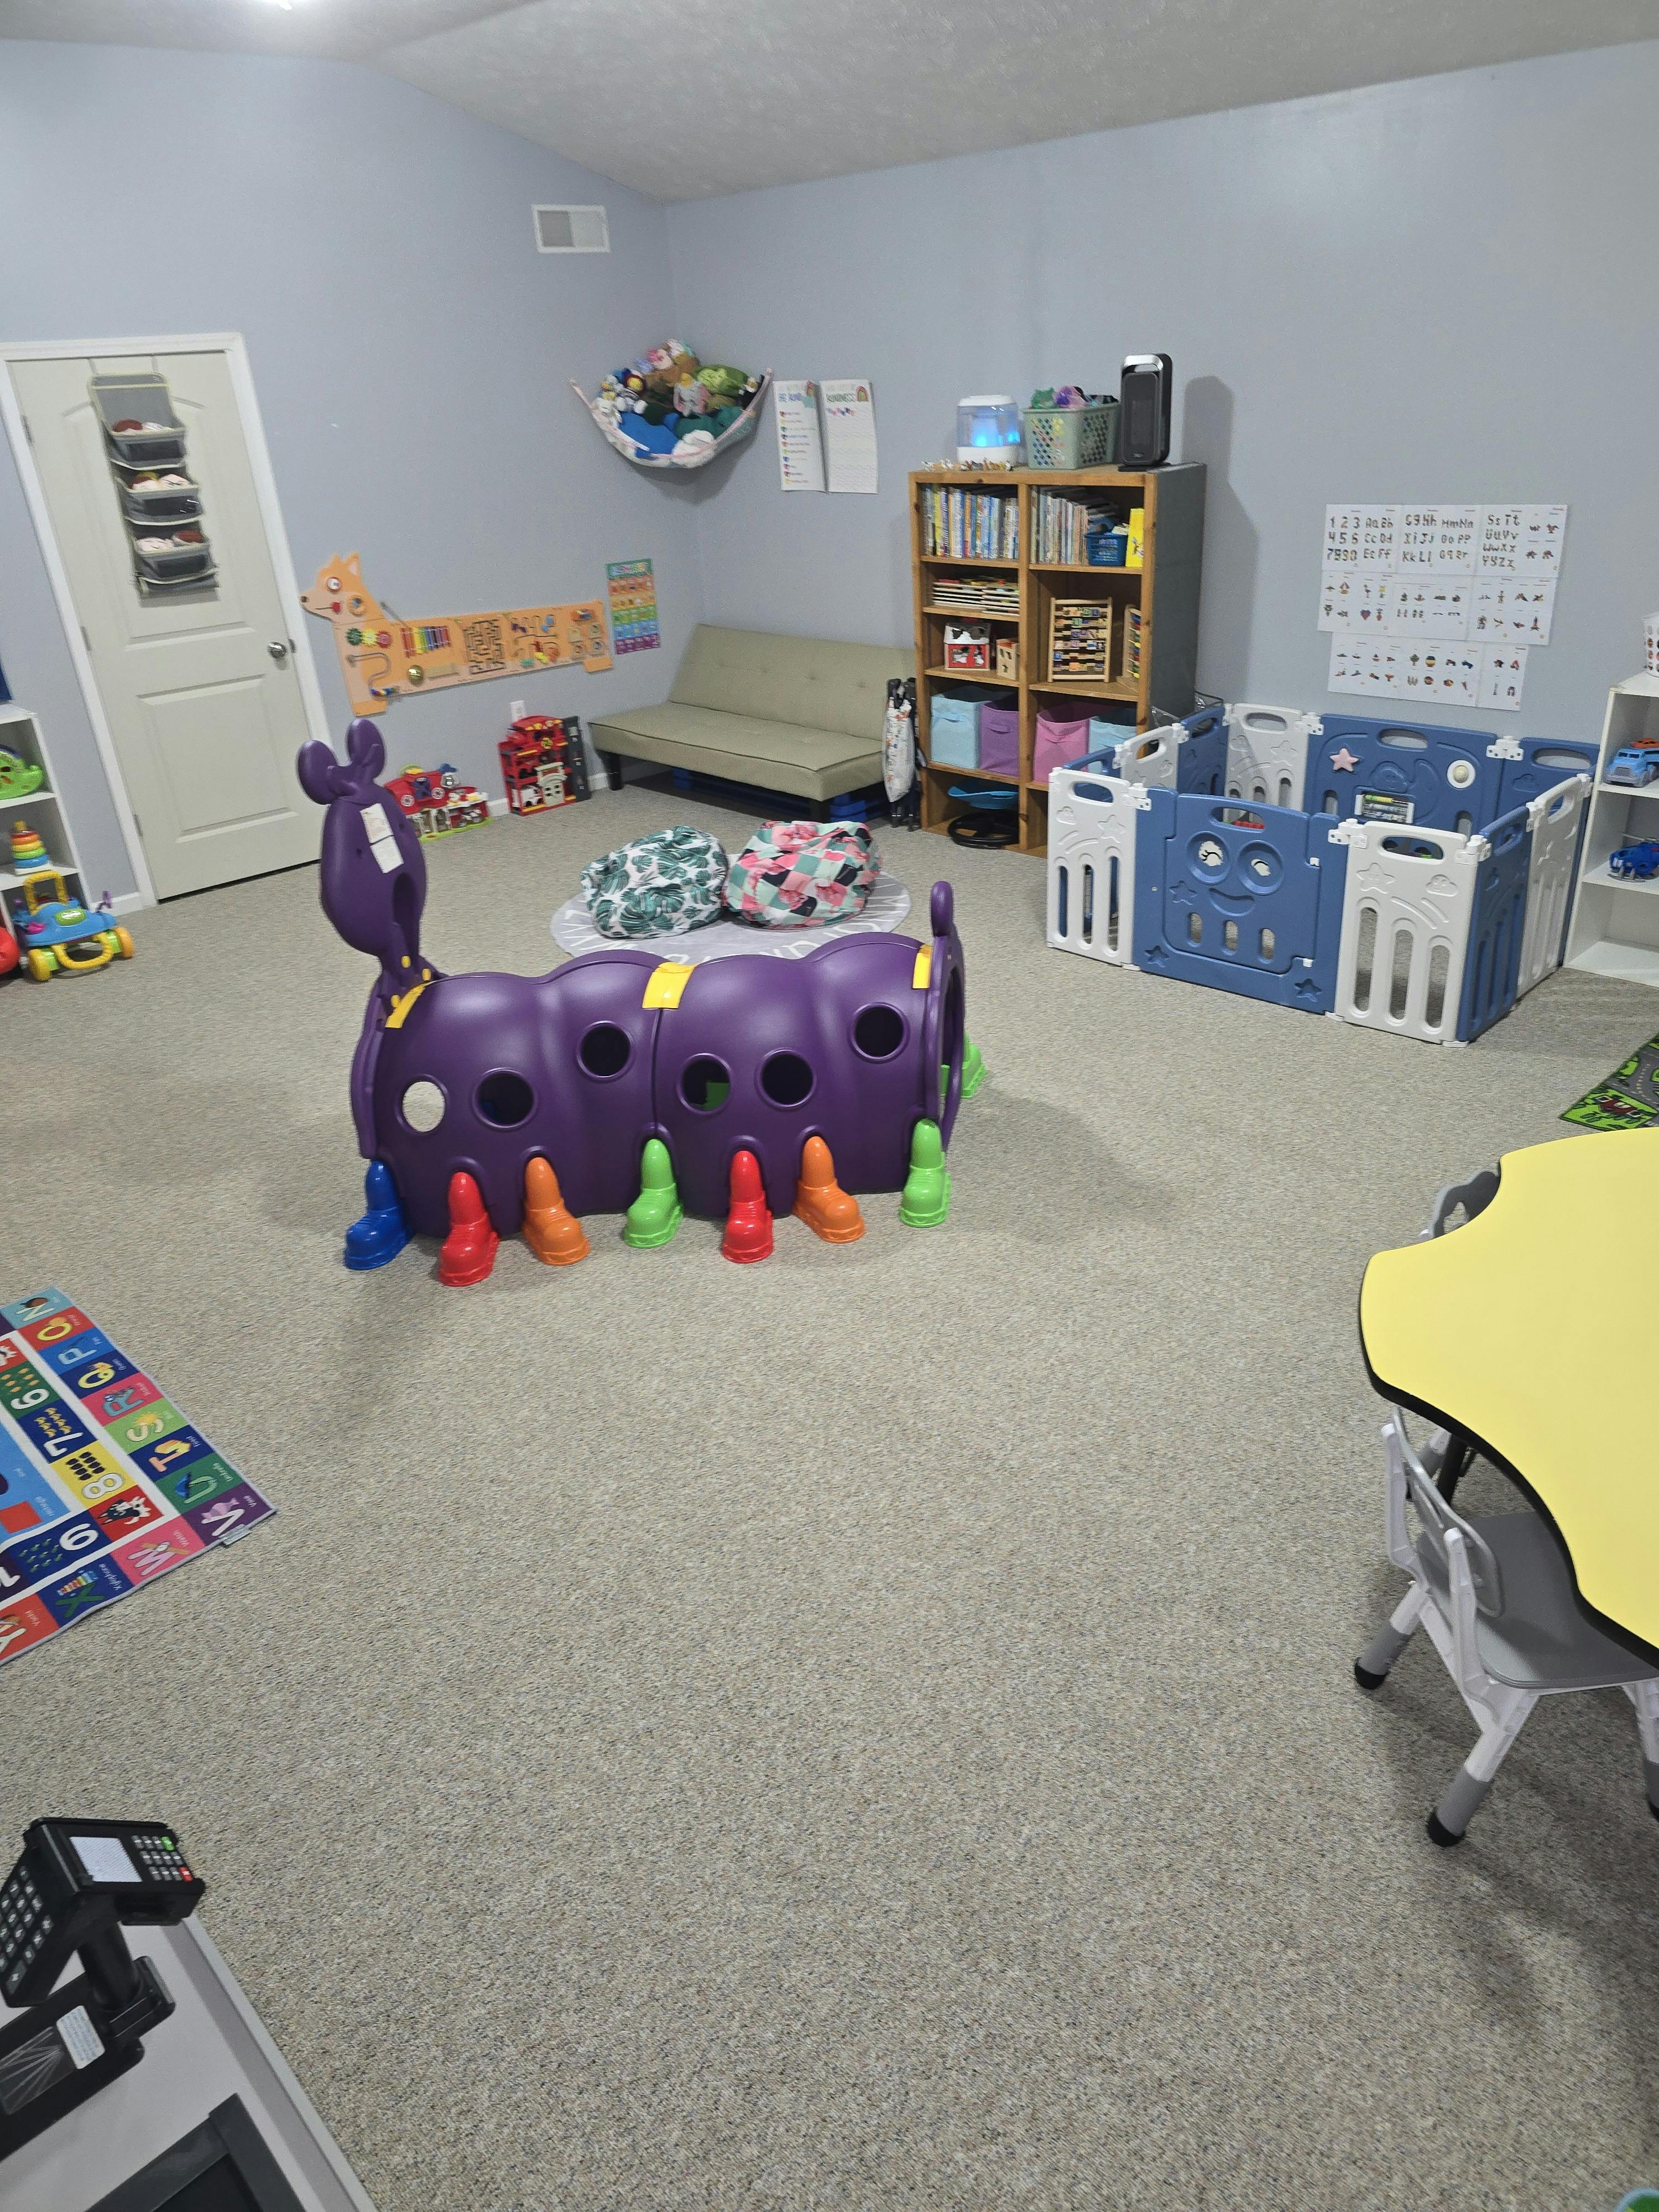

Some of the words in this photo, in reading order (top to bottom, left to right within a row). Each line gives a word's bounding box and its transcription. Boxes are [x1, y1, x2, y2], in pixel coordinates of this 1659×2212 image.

[1330, 516, 1335, 528] 1
[1340, 516, 1348, 529] 2
[1353, 516, 1360, 529] 3
[1328, 531, 1336, 544] 4
[1339, 532, 1348, 545] 5
[1352, 532, 1359, 545] 6
[36, 1321, 73, 1342] O
[58, 1348, 97, 1365] P
[77, 1368, 116, 1389] Q
[10, 1387, 50, 1410] 6
[102, 1387, 145, 1417] R
[126, 1416, 165, 1442] S
[43, 1432, 84, 1457] 7
[81, 1472, 125, 1500] 8
[183, 1474, 219, 1505] U
[201, 1507, 246, 1537] V
[127, 1541, 176, 1577] W
[98, 1562, 123, 1592] Xylophone
[54, 1580, 106, 1619] X
